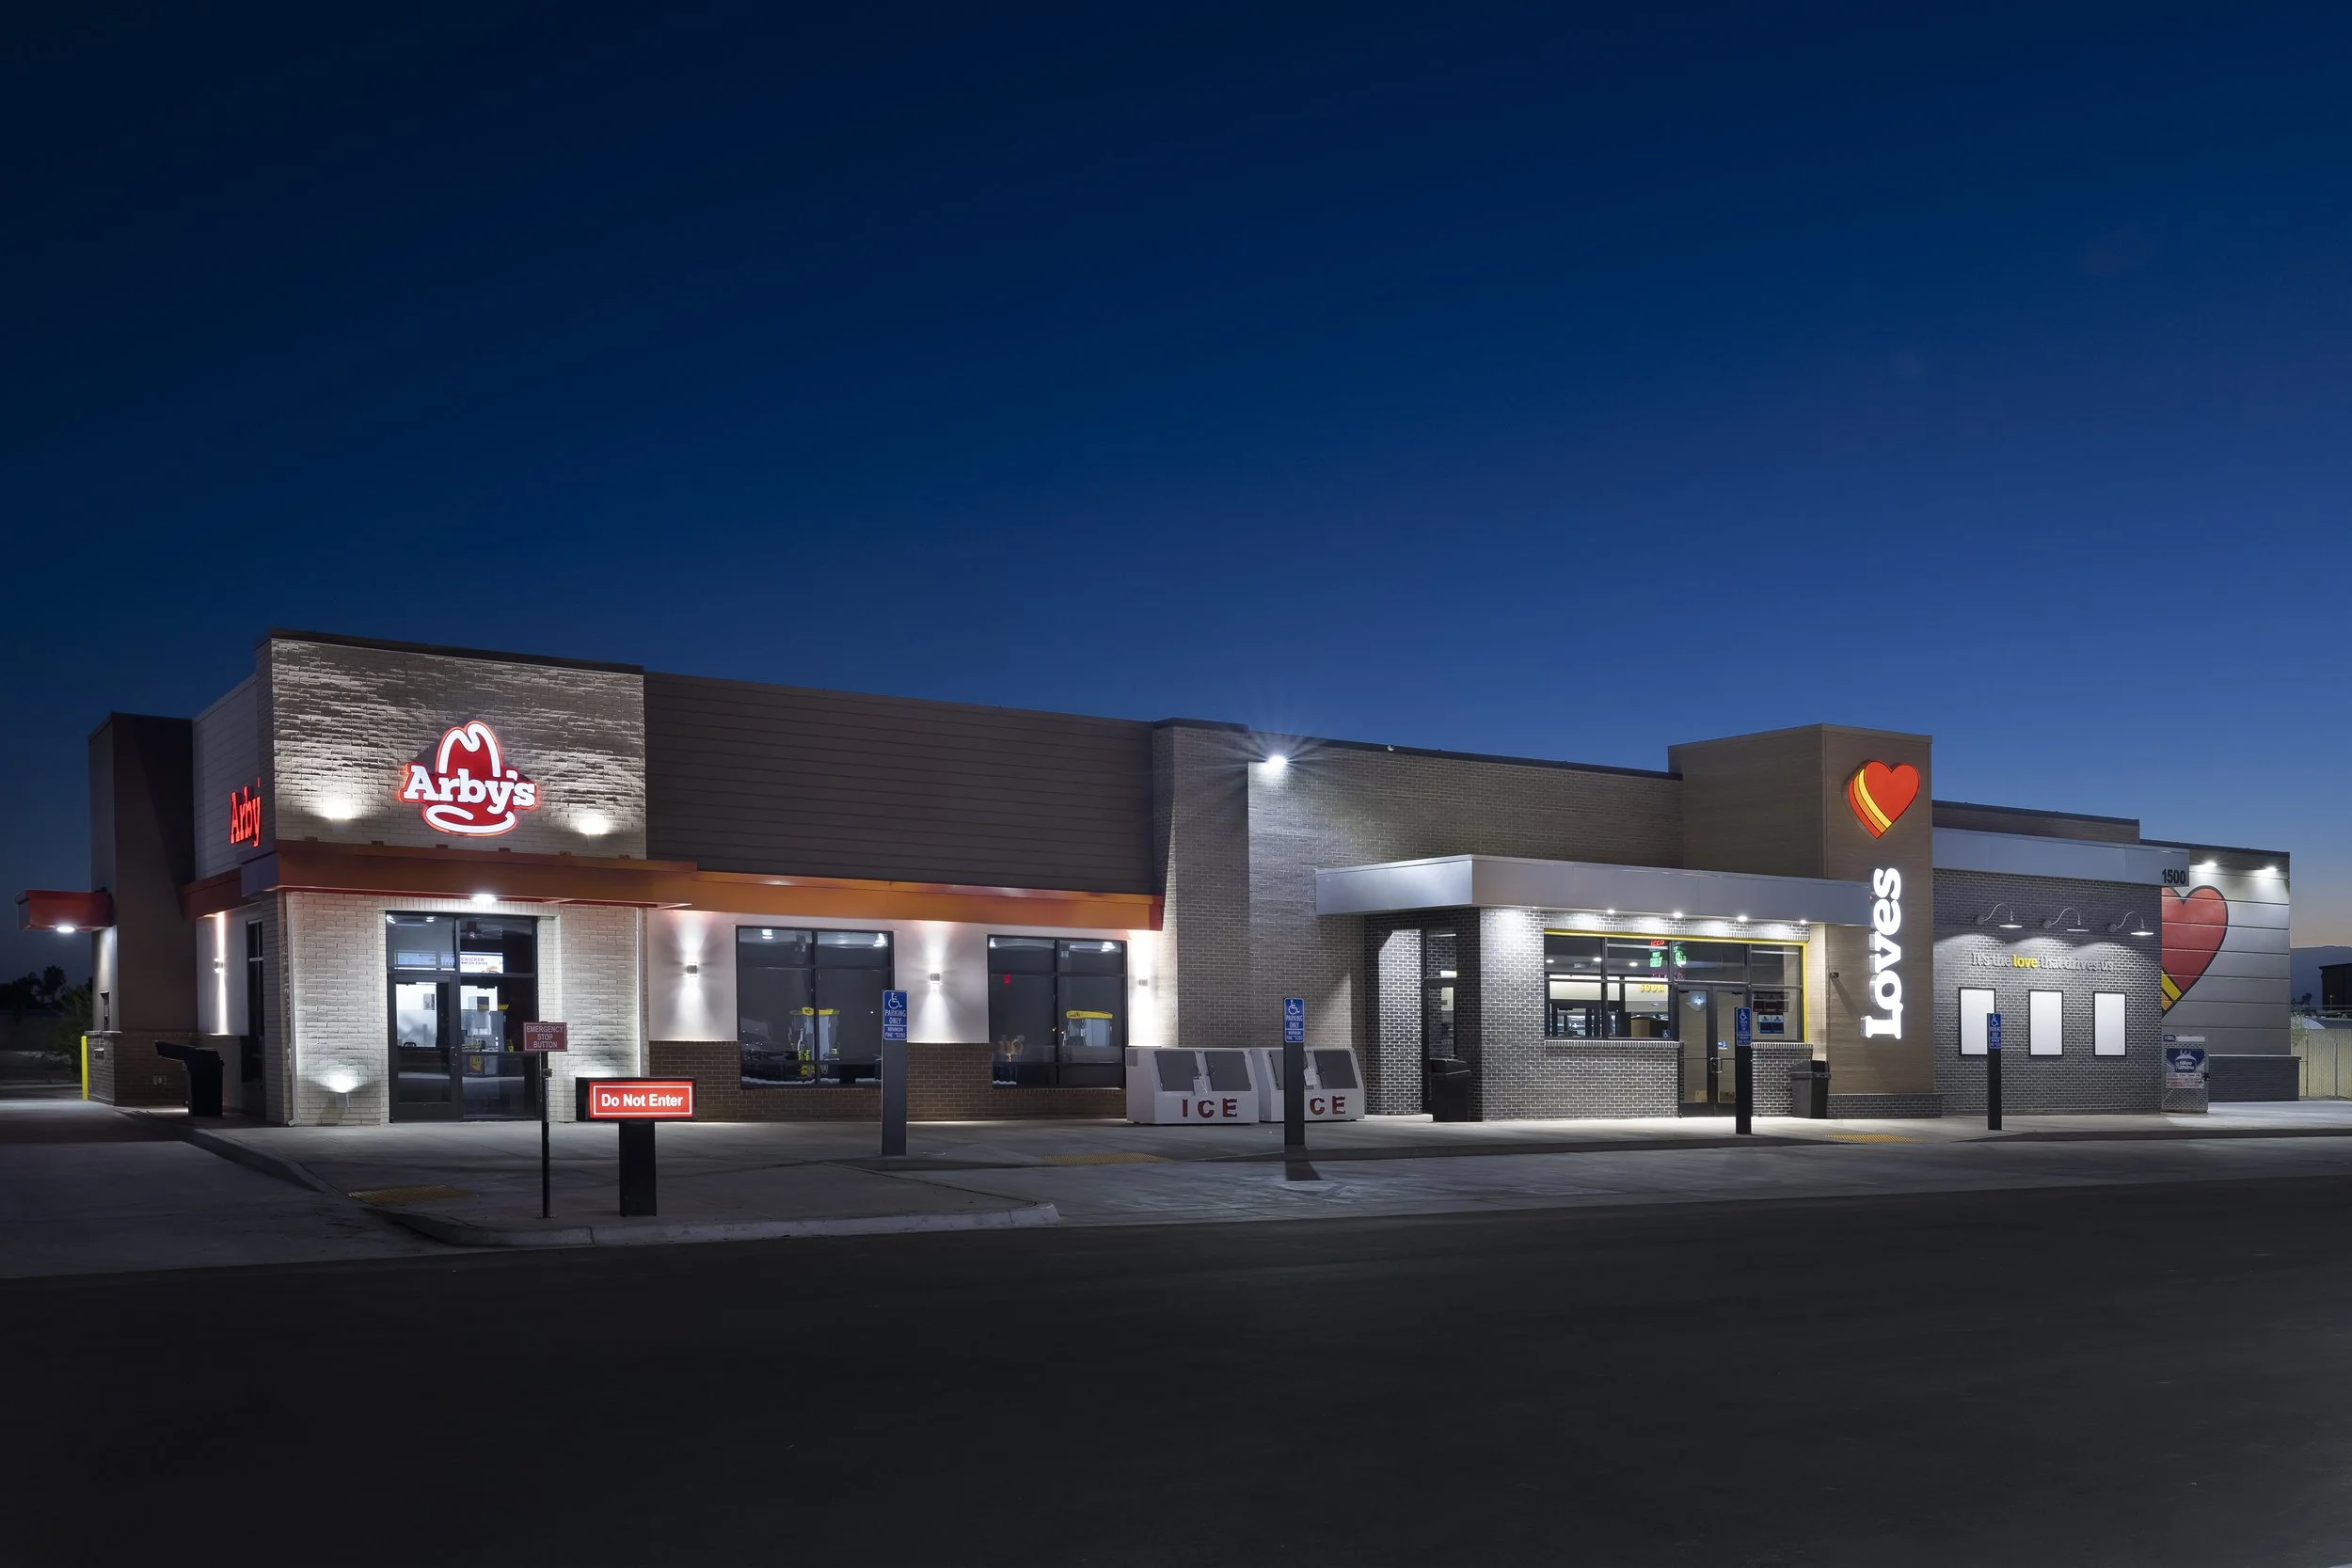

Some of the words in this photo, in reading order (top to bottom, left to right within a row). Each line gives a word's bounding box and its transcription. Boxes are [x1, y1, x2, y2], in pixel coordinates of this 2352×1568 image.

[403, 765, 536, 815] Arby's
[2161, 868, 2186, 884] 1500
[1863, 867, 1904, 1039] Loves
[1972, 952, 1991, 966] It's
[1993, 954, 2011, 967] the
[2012, 954, 2038, 968] love
[2040, 956, 2063, 969] that
[2064, 958, 2099, 972] drives
[532, 1040, 558, 1049] BUTTON
[601, 1093, 620, 1107] Do
[623, 1093, 646, 1107] Not
[648, 1093, 684, 1107] Enter
[1182, 1097, 1238, 1118] ICE
[1309, 1096, 1346, 1116] CE
